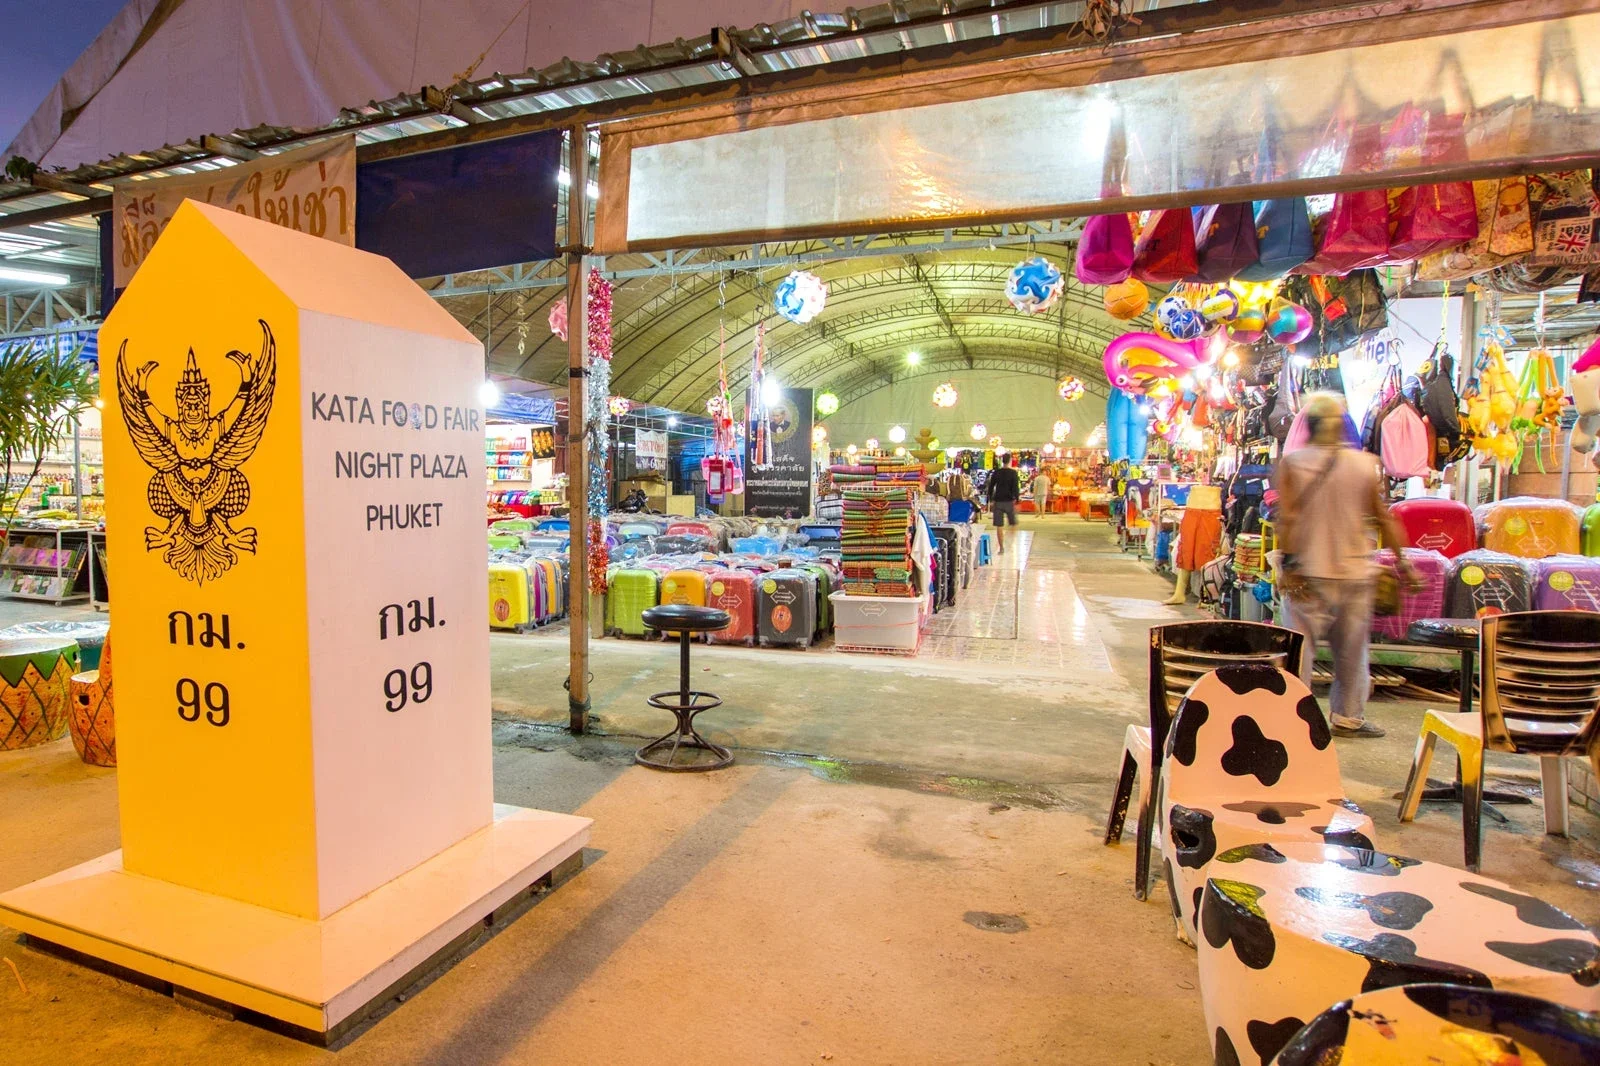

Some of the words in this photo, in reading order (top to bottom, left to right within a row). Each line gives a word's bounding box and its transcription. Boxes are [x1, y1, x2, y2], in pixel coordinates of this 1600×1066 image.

[312, 391, 374, 425] KATA
[382, 400, 438, 430] FOOD
[443, 407, 479, 432] FAIR
[335, 450, 404, 479] NIGHT
[410, 453, 468, 478] PLAZA
[366, 503, 443, 531] PHUKET
[168, 610, 246, 650] กม.
[378, 596, 446, 640] กม.
[176, 678, 230, 727] 99
[383, 661, 433, 712] 99
